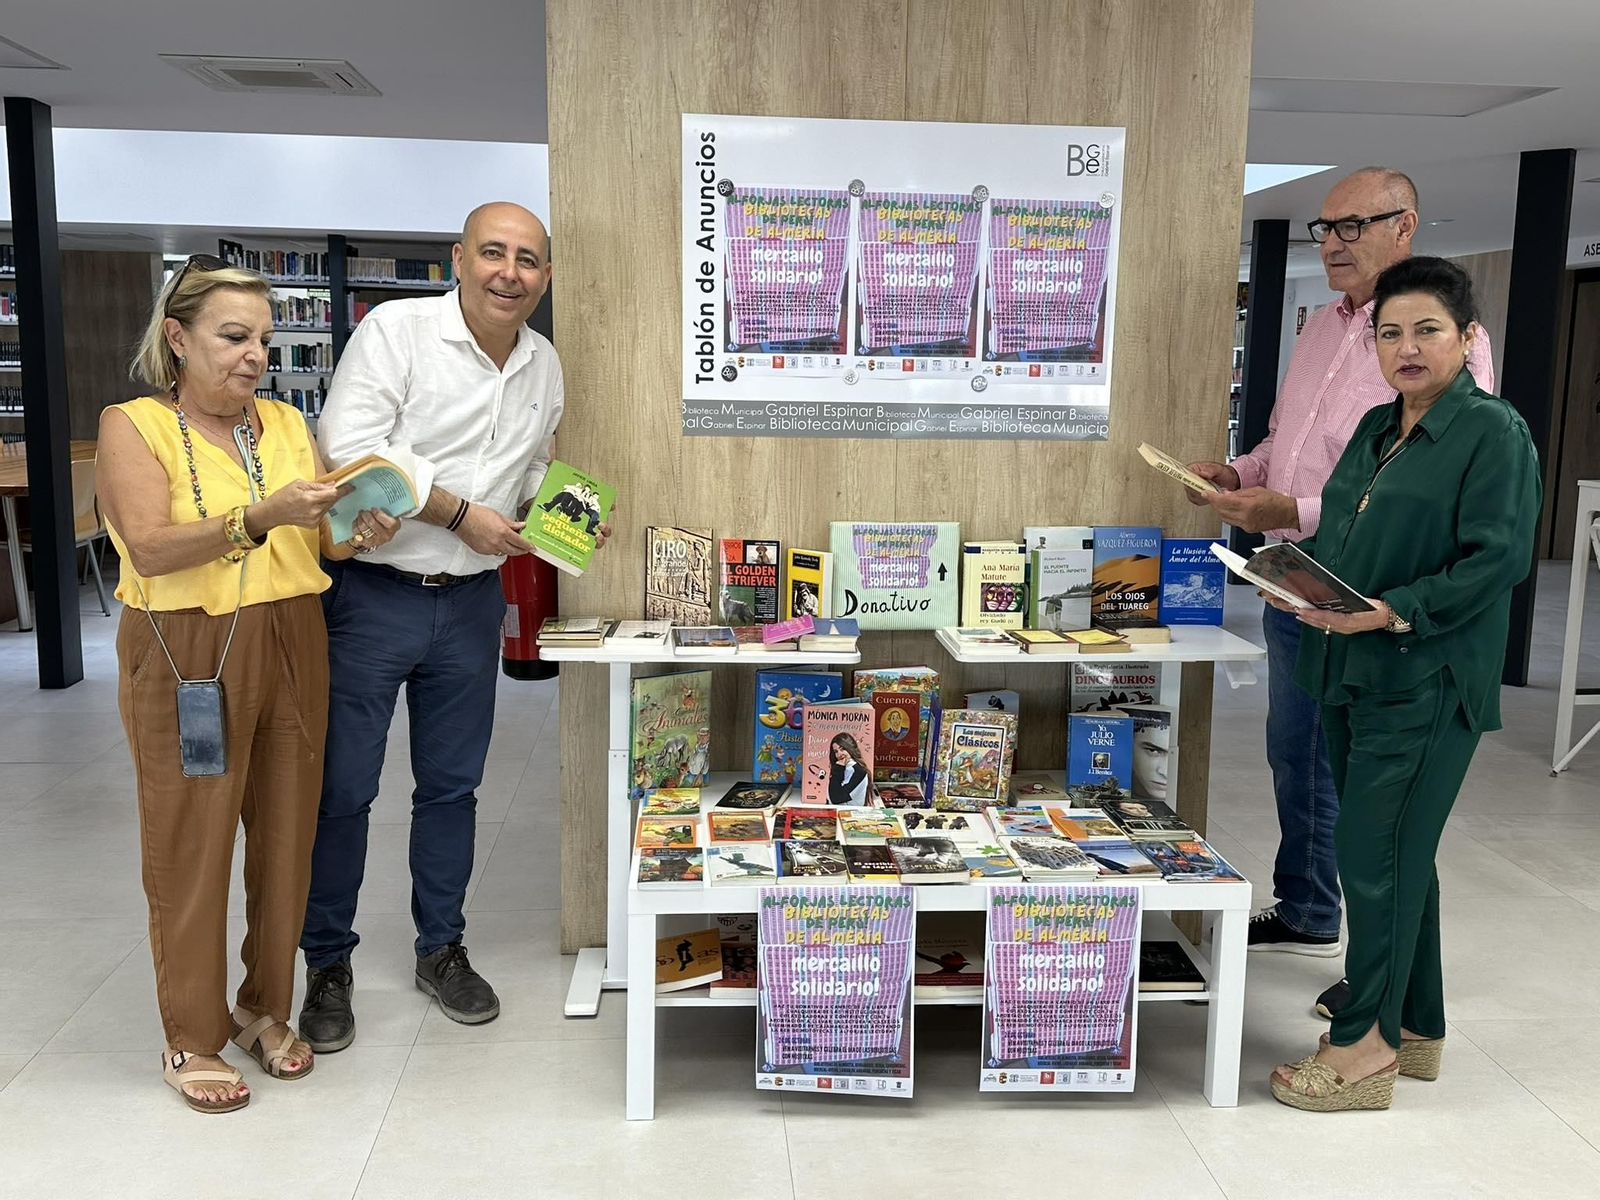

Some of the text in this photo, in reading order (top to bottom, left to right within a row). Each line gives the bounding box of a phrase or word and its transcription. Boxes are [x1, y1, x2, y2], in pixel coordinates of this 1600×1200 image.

[726, 195, 849, 209] ALFORJAS LECTORAS
[861, 200, 980, 213] ALFORJAS LECTORAS
[744, 203, 832, 218] BIBLIOTECAS
[877, 208, 963, 223] BIBLIOTECAS
[991, 206, 1110, 219] ALFORJAS LECTORAS
[762, 215, 776, 224] DE
[895, 219, 909, 229] DE
[1008, 215, 1093, 229] BIBLIOTECAS
[745, 226, 761, 237] DE
[878, 230, 894, 241] DE
[1025, 225, 1039, 235] DE
[1008, 236, 1023, 247] DE
[693, 131, 716, 384] Tablón de Anuncios
[750, 247, 824, 263] mercaillo
[883, 251, 955, 267] mercaillo
[1012, 257, 1083, 274] mercaillo
[750, 267, 823, 284] solidario!
[881, 271, 954, 288] solidario!
[1010, 277, 1082, 293] solidario!
[721, 403, 763, 416] Municipal
[765, 403, 819, 417] Gabriel
[823, 404, 872, 420] Espinar
[876, 405, 916, 419] Biblioteca
[917, 407, 959, 419] Municipal
[960, 407, 1013, 420] Gabriel
[1017, 408, 1067, 422] Espinar
[1069, 408, 1109, 421] Biblioteca
[700, 416, 735, 429] Gabriel
[736, 417, 766, 430] Espinar
[769, 418, 840, 431] Biblioteca
[842, 419, 912, 434] Municipal
[914, 420, 947, 432] Gabriel
[949, 420, 978, 433] Espinar
[981, 421, 1051, 433] Biblioteca
[1052, 422, 1109, 436] Municip
[558, 512, 572, 524] El
[540, 512, 589, 542] pequeño
[542, 522, 591, 553] dictador
[653, 539, 687, 558] CIRO
[1172, 547, 1206, 555] La Ilusión
[735, 565, 776, 576] GOLDEN
[981, 563, 1020, 572] Ana María
[981, 573, 1007, 581] Matute
[836, 589, 931, 617] Donativo
[1118, 602, 1149, 610] TUAREG
[875, 696, 917, 705] Cuentos
[807, 709, 870, 722] MÓNICA MORÁN
[974, 729, 997, 737] mejores
[1090, 731, 1114, 739] JULIO
[956, 735, 1000, 749] Clásicos
[1087, 738, 1116, 747] VERNE
[762, 895, 911, 909] ALFORJAS LECTORAS
[992, 894, 1137, 908] ALFORJAS LECTORAS
[783, 905, 891, 920] BIBLIOTECAS
[1012, 904, 1116, 920] BIBLIOTECAS
[805, 917, 823, 929] DE
[1034, 916, 1050, 927] DE
[786, 931, 806, 944] DE
[1013, 929, 1033, 942] DE
[791, 953, 881, 973] mercaillo
[1019, 950, 1106, 970] mercaillo
[790, 976, 880, 997] solidario!
[1017, 973, 1104, 992] solidario!
